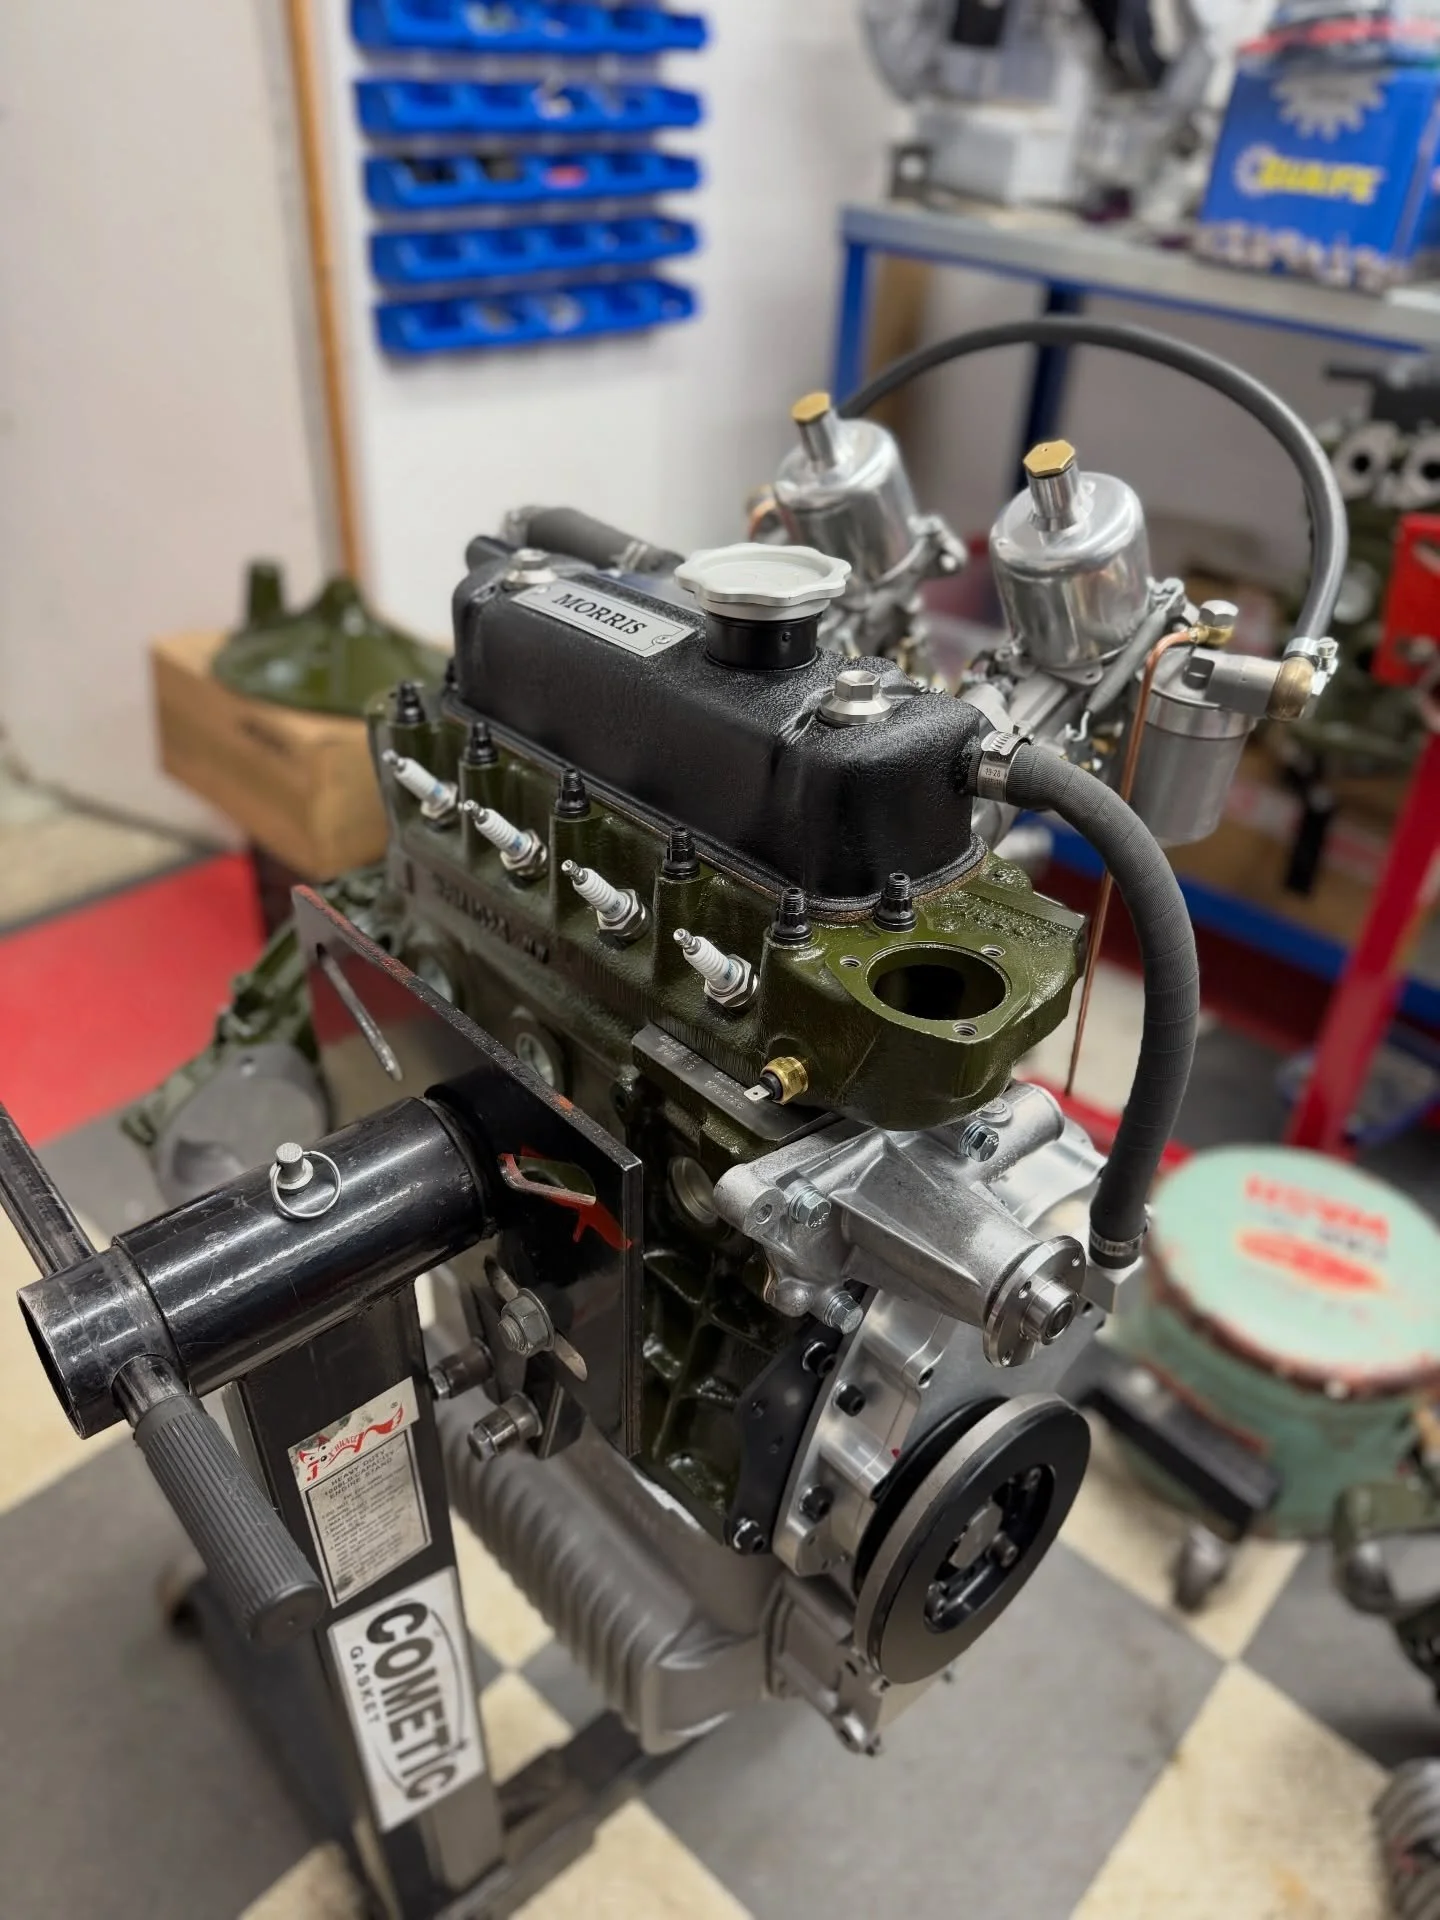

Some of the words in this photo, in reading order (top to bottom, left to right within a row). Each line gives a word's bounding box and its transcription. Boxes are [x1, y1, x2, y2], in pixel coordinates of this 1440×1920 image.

[552, 593, 648, 635] MORRIS
[329, 1476, 361, 1500] ENGINE
[331, 1466, 359, 1487] HEAVY
[350, 1645, 381, 1725] GASKET
[366, 1602, 457, 1802] COMETIC
